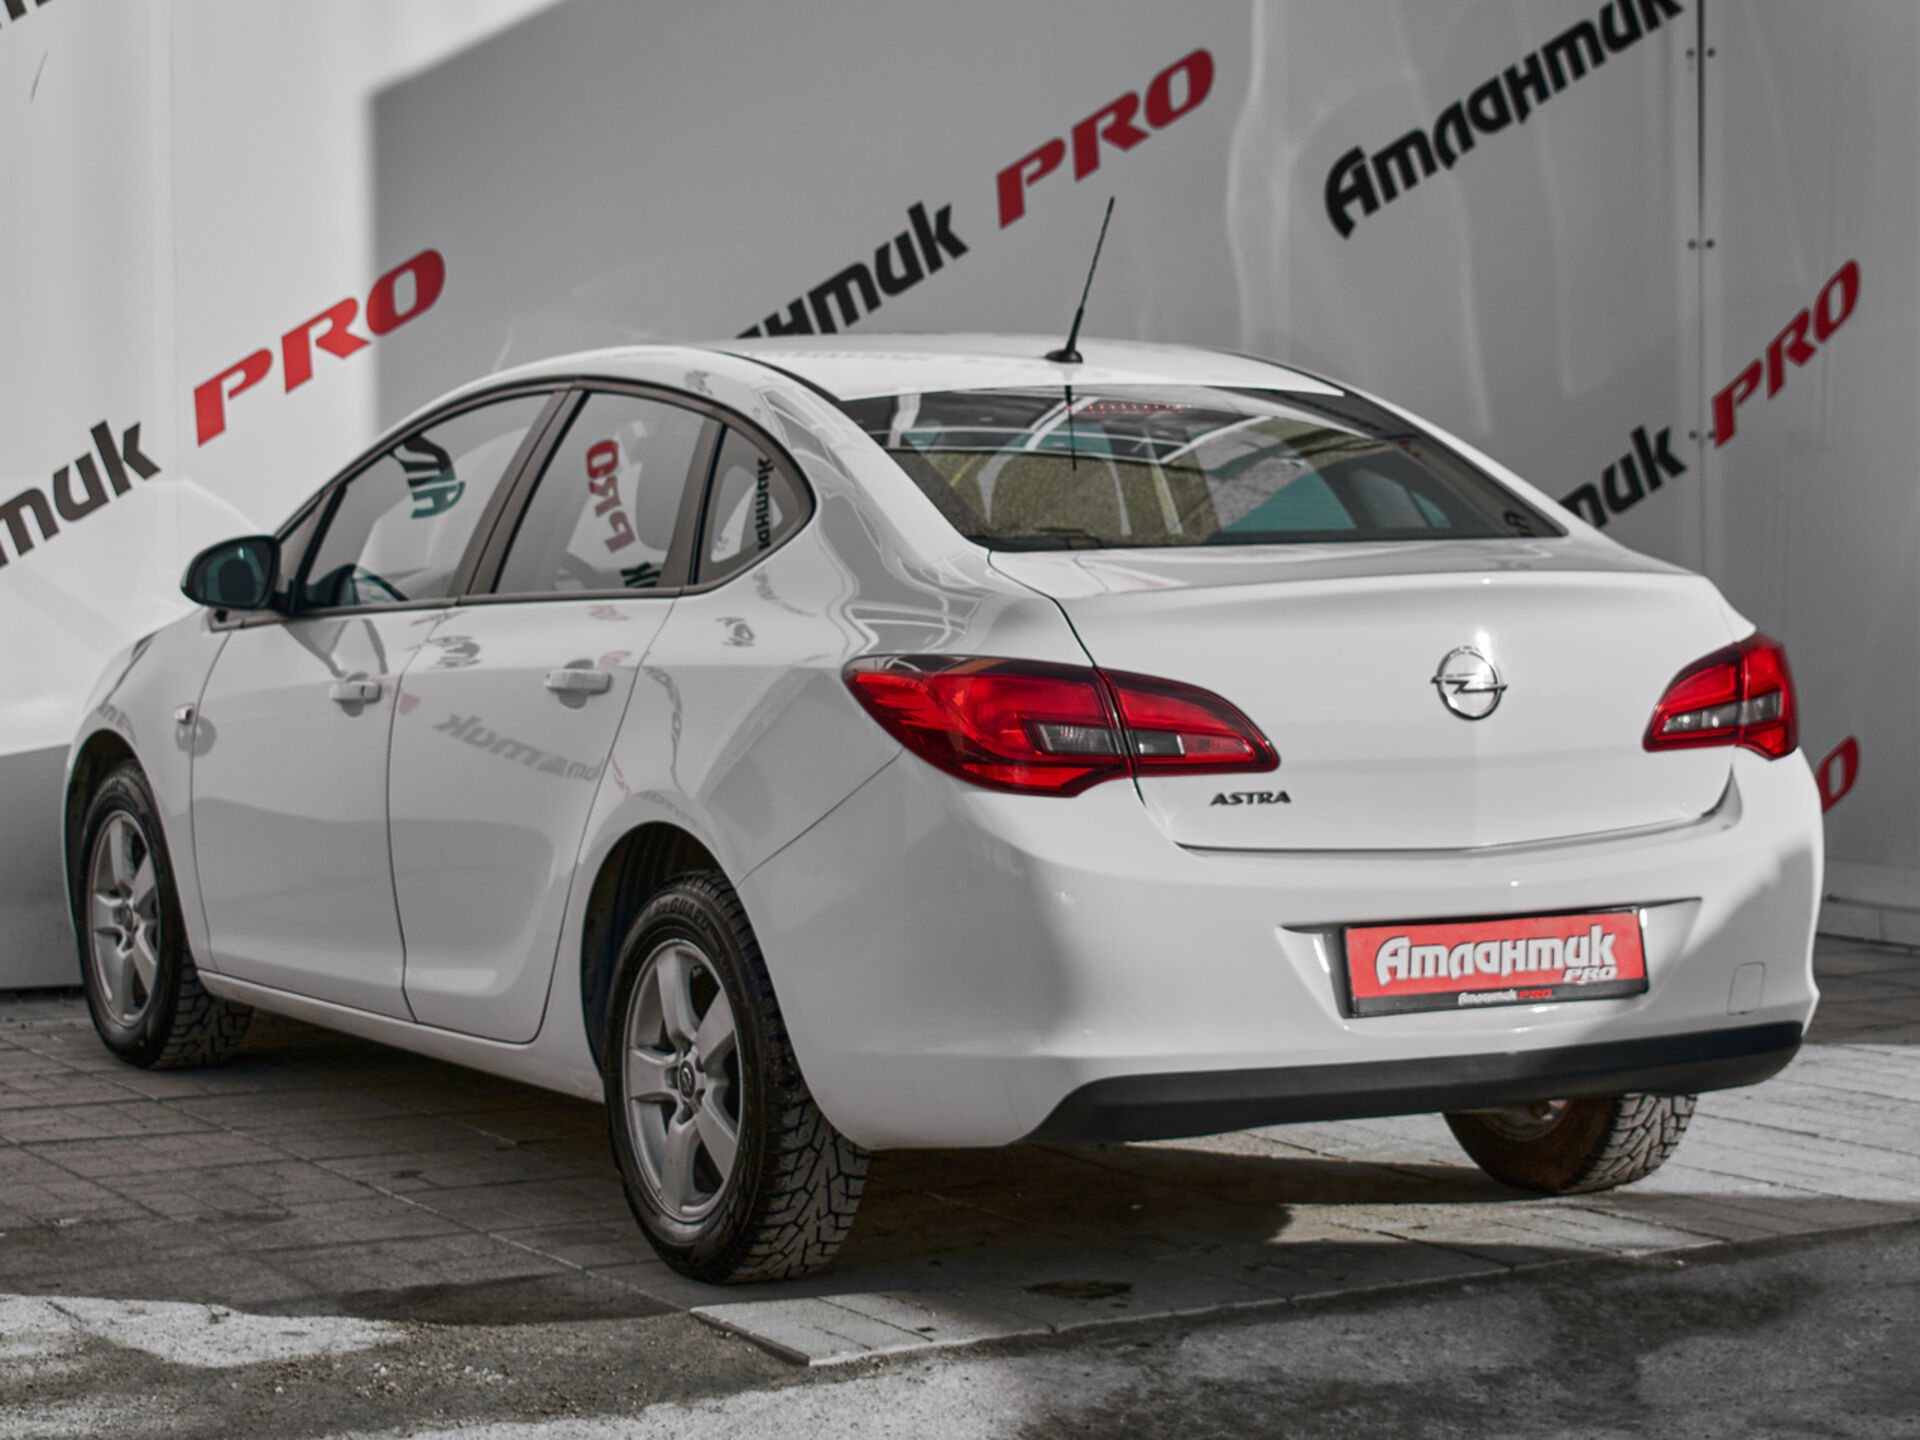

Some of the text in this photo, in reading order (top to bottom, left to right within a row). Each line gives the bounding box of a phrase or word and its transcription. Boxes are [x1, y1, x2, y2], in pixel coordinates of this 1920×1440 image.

[996, 48, 1214, 230] PRO
[194, 249, 446, 447] PRO
[1712, 258, 1861, 448] PRO
[1209, 790, 1291, 806] ASTRA
[1376, 924, 1618, 986] Атлантик
[1563, 965, 1619, 983] PRO
[1518, 988, 1552, 1000] PRO
